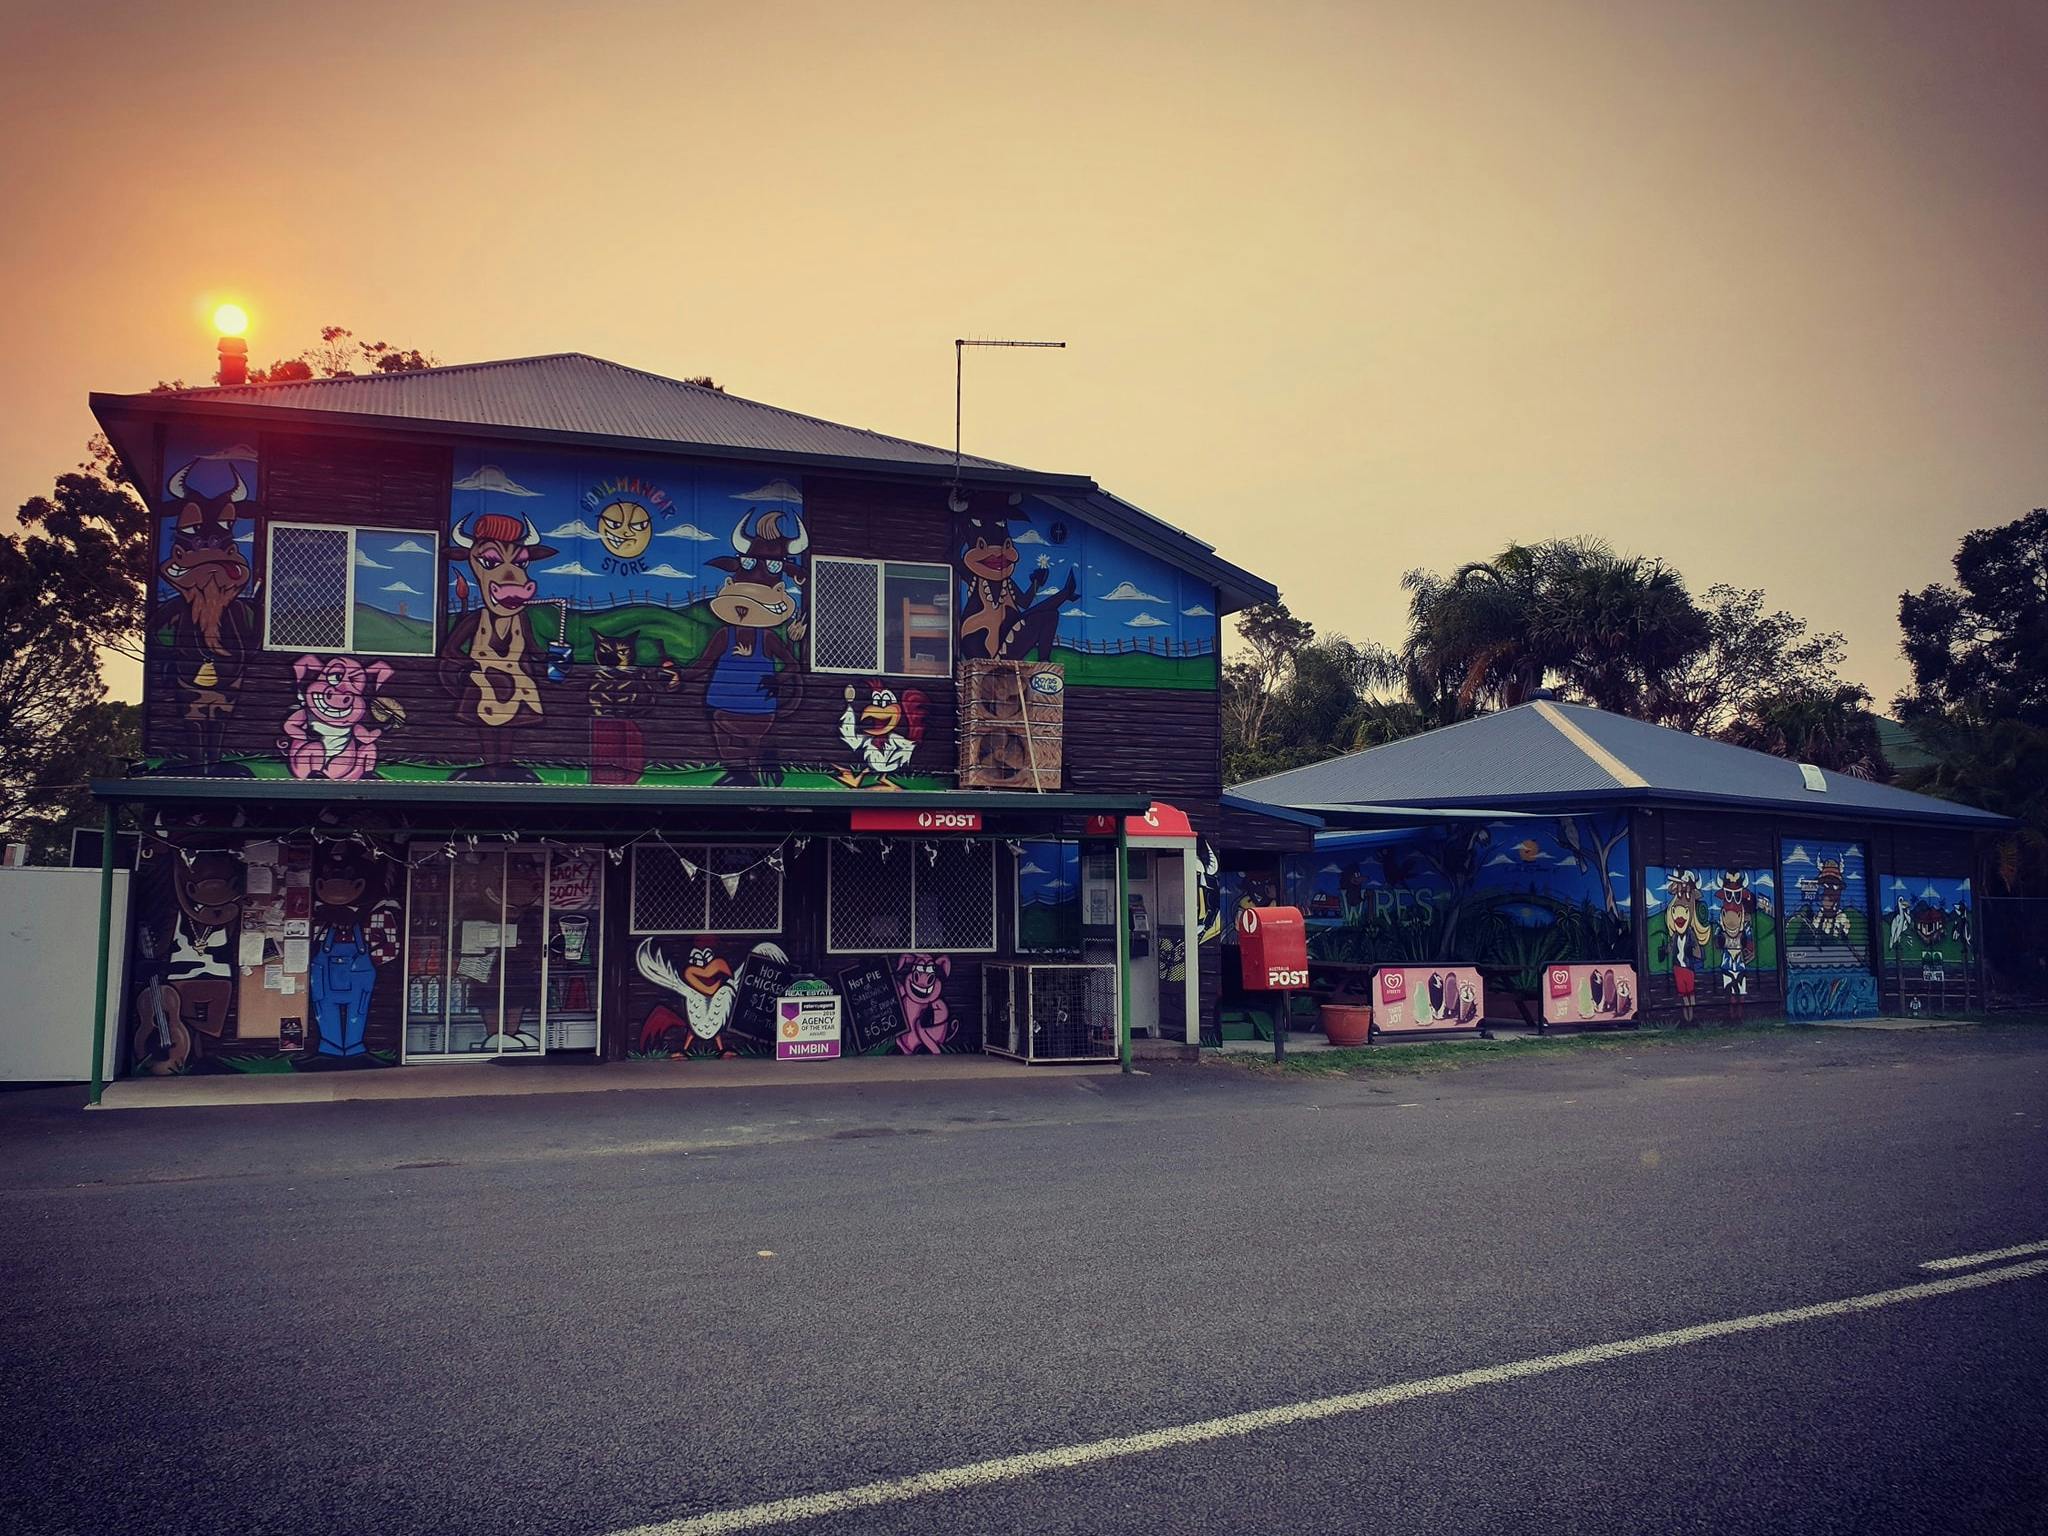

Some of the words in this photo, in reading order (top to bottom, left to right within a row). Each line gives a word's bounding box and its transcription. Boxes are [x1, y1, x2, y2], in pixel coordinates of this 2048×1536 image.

[601, 557, 649, 576] STORE
[935, 814, 976, 827] POST
[760, 964, 782, 981] HOT
[865, 969, 882, 983] PIE
[1268, 970, 1309, 986] POST
[801, 1016, 835, 1025] AGENCY
[789, 1043, 829, 1055] NIMBIN
